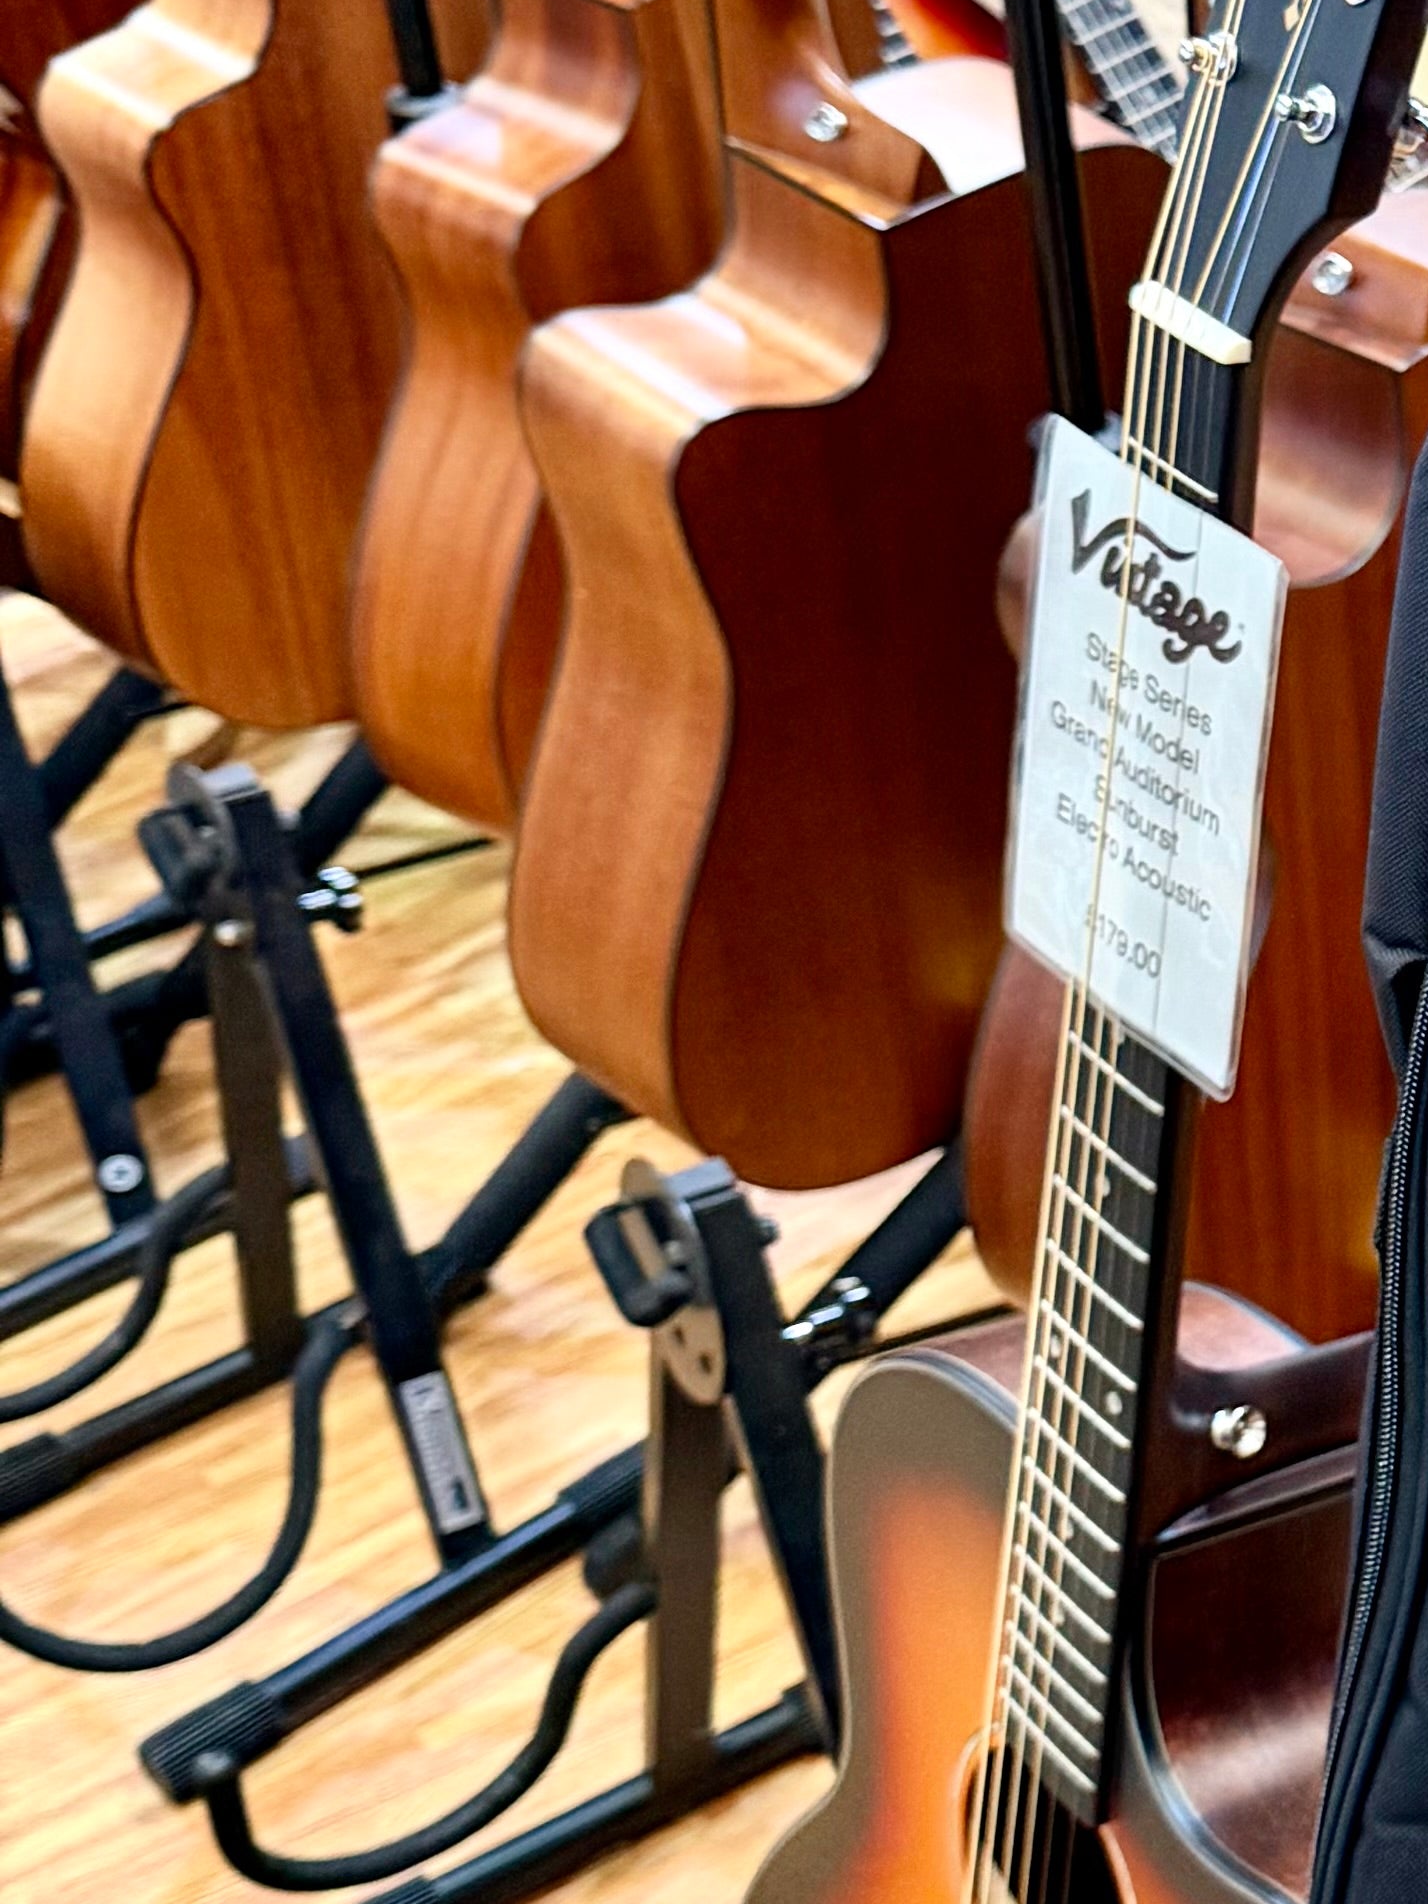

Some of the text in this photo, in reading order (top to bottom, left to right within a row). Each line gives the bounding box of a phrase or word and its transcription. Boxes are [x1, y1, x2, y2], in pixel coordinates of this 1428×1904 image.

[1071, 487, 1243, 664] Vintage
[1136, 712, 1201, 775] Model
[1143, 673, 1213, 737] Series
[1114, 746, 1221, 837] Auditorium
[1121, 846, 1212, 923] Acoustic
